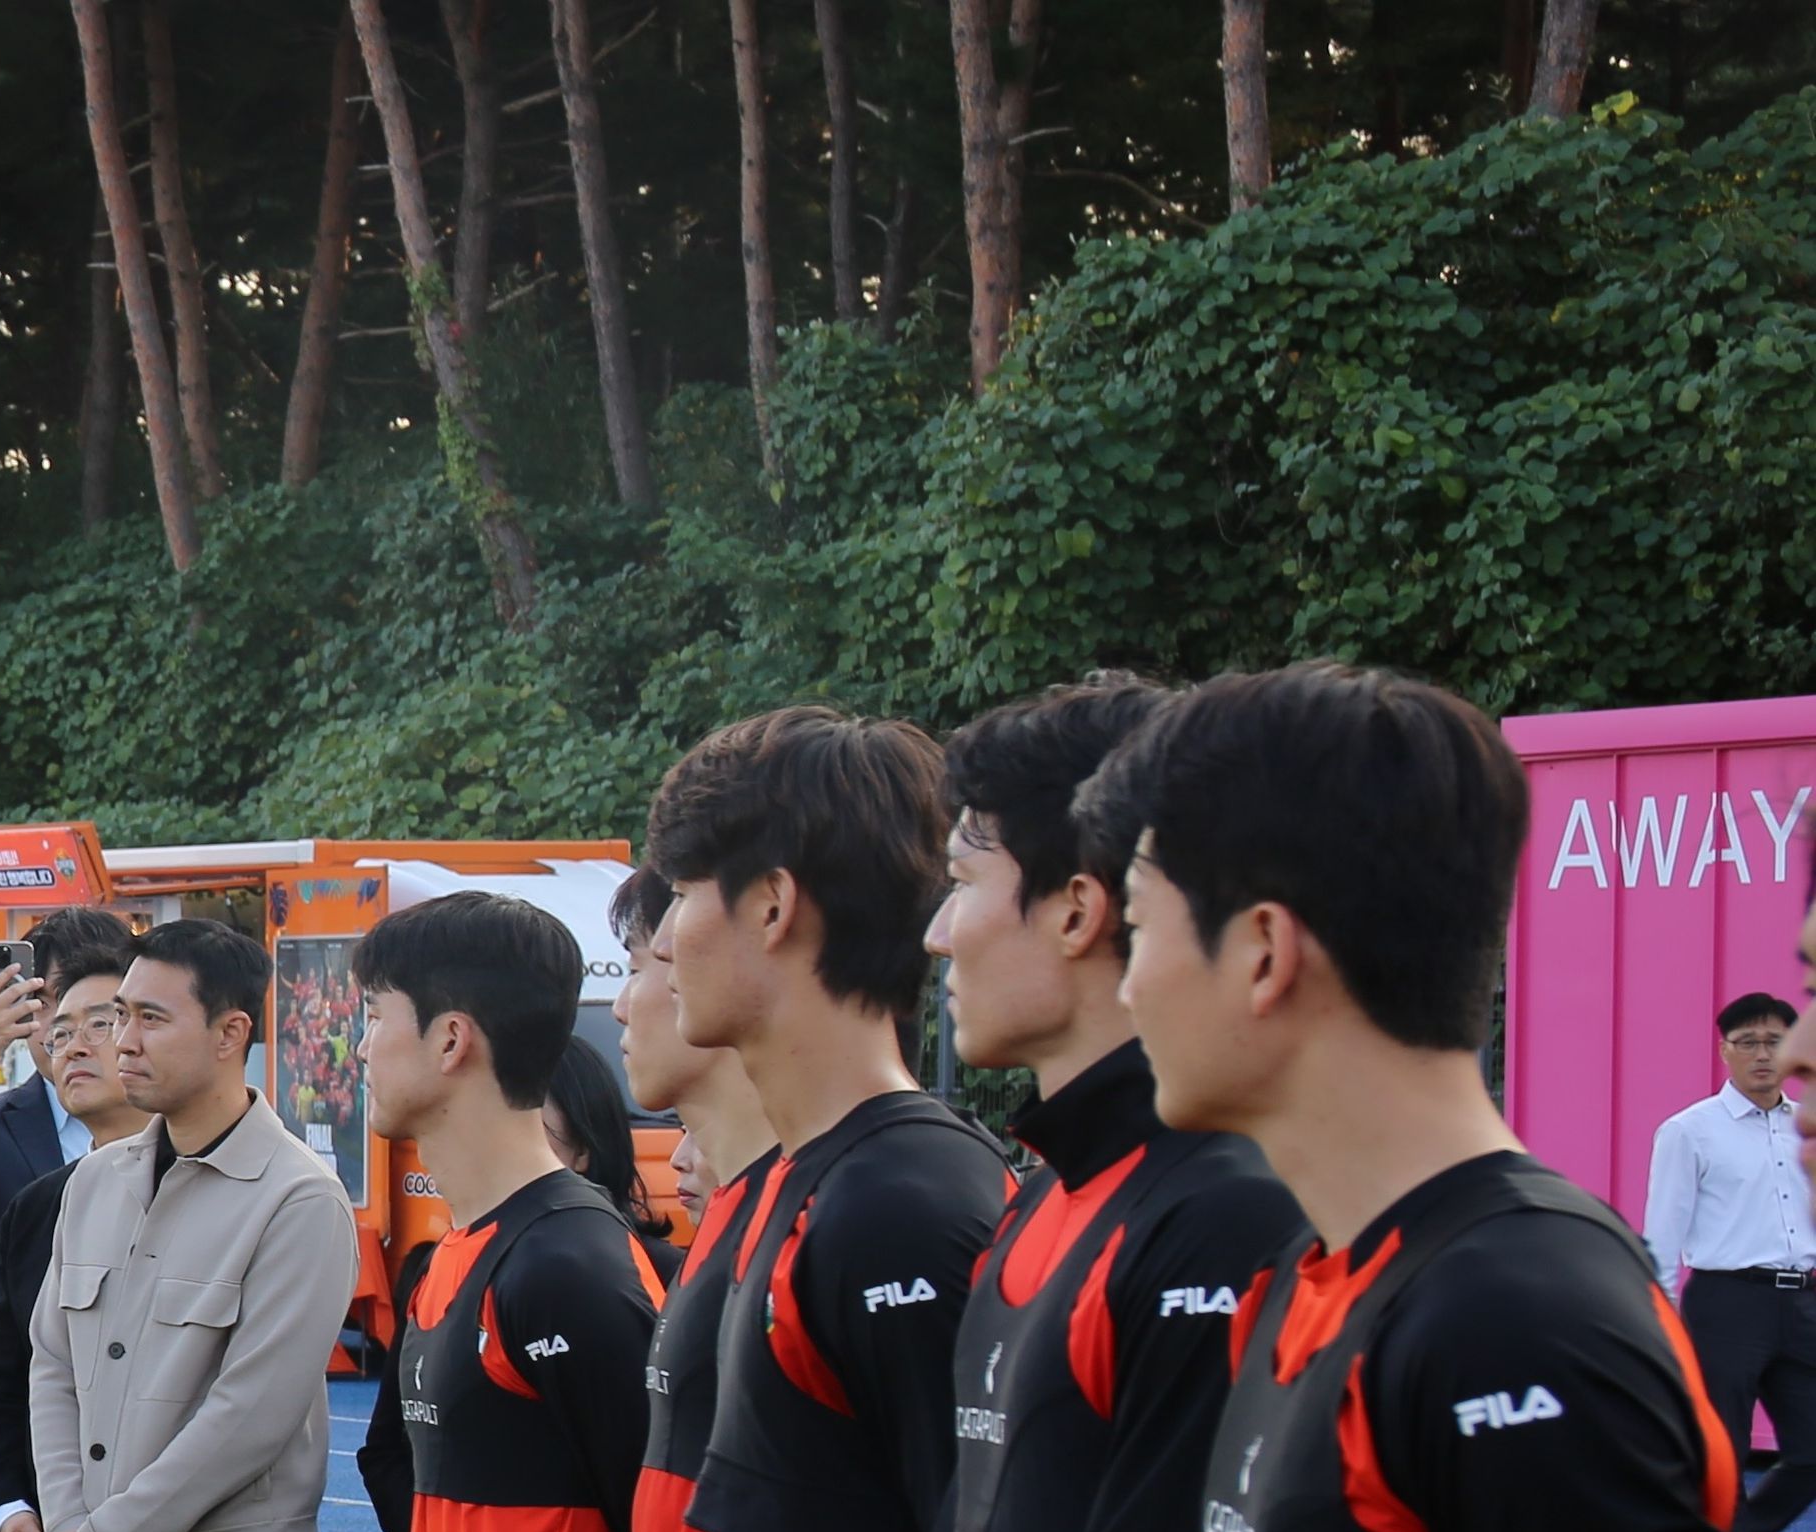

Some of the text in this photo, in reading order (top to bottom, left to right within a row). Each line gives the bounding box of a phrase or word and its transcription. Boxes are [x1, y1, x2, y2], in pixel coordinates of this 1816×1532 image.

[1548, 786, 1812, 890] AWAY
[582, 961, 623, 977] CO
[403, 1172, 443, 1198] COC
[863, 1277, 937, 1313] FILA
[1160, 1286, 1238, 1317] FILA
[525, 1334, 570, 1361] FILA
[956, 1406, 1007, 1445] CATAPULT
[1452, 1384, 1563, 1437] FILA
